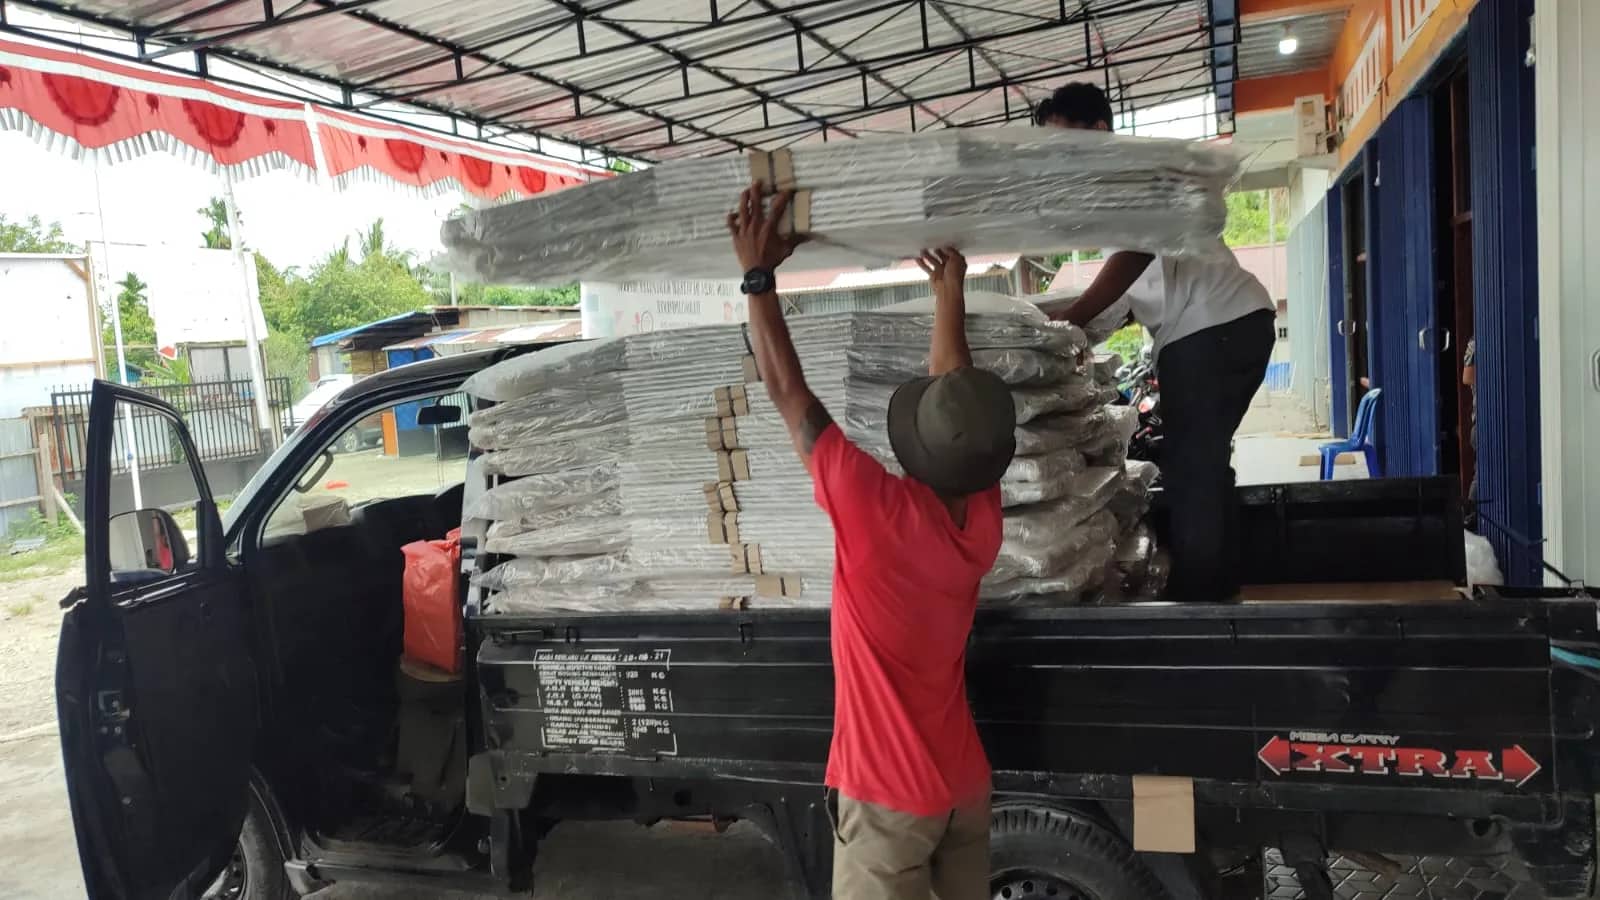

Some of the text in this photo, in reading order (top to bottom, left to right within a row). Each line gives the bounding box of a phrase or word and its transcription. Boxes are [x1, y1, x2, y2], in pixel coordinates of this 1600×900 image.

[1290, 732, 1400, 744] MEGA CARRY
[1293, 743, 1503, 780] XTRA
